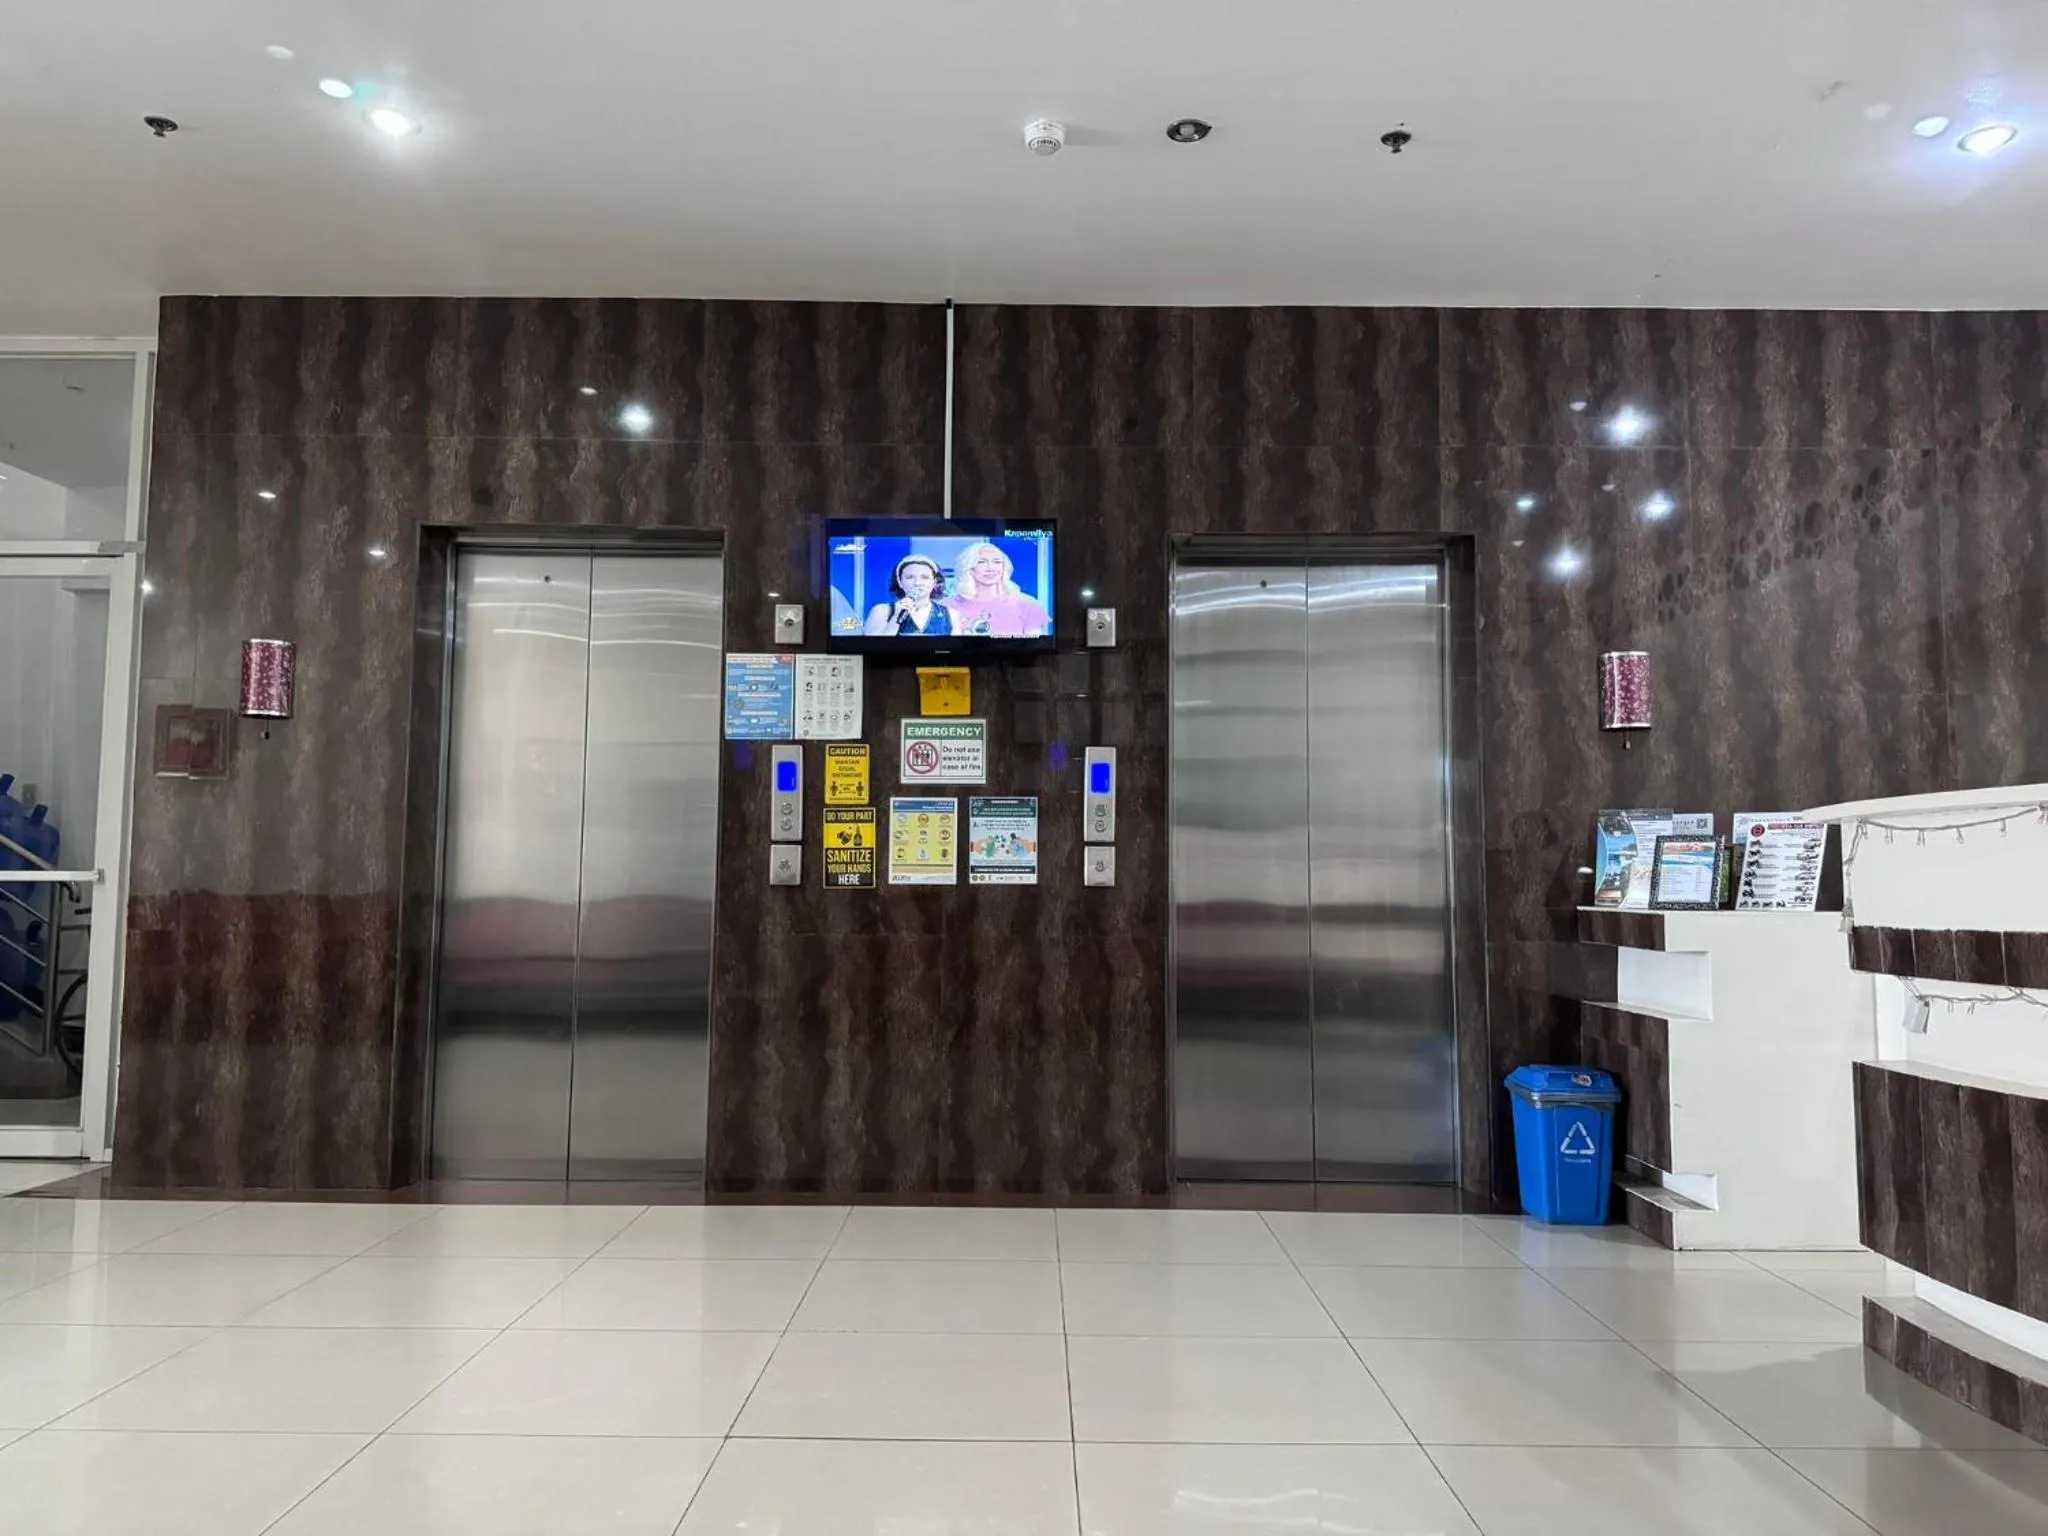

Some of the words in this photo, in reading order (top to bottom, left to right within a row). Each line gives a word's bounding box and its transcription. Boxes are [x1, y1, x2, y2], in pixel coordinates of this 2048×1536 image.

[907, 727, 981, 737] EMERGENCY
[830, 747, 866, 755] CAUTION
[827, 812, 836, 821] DO
[837, 811, 855, 821] YOUR
[855, 811, 873, 820] PART
[827, 849, 872, 863] SANITIZE
[828, 863, 846, 873] YOUR
[847, 863, 872, 873] HANDS
[838, 874, 860, 885] HERE
